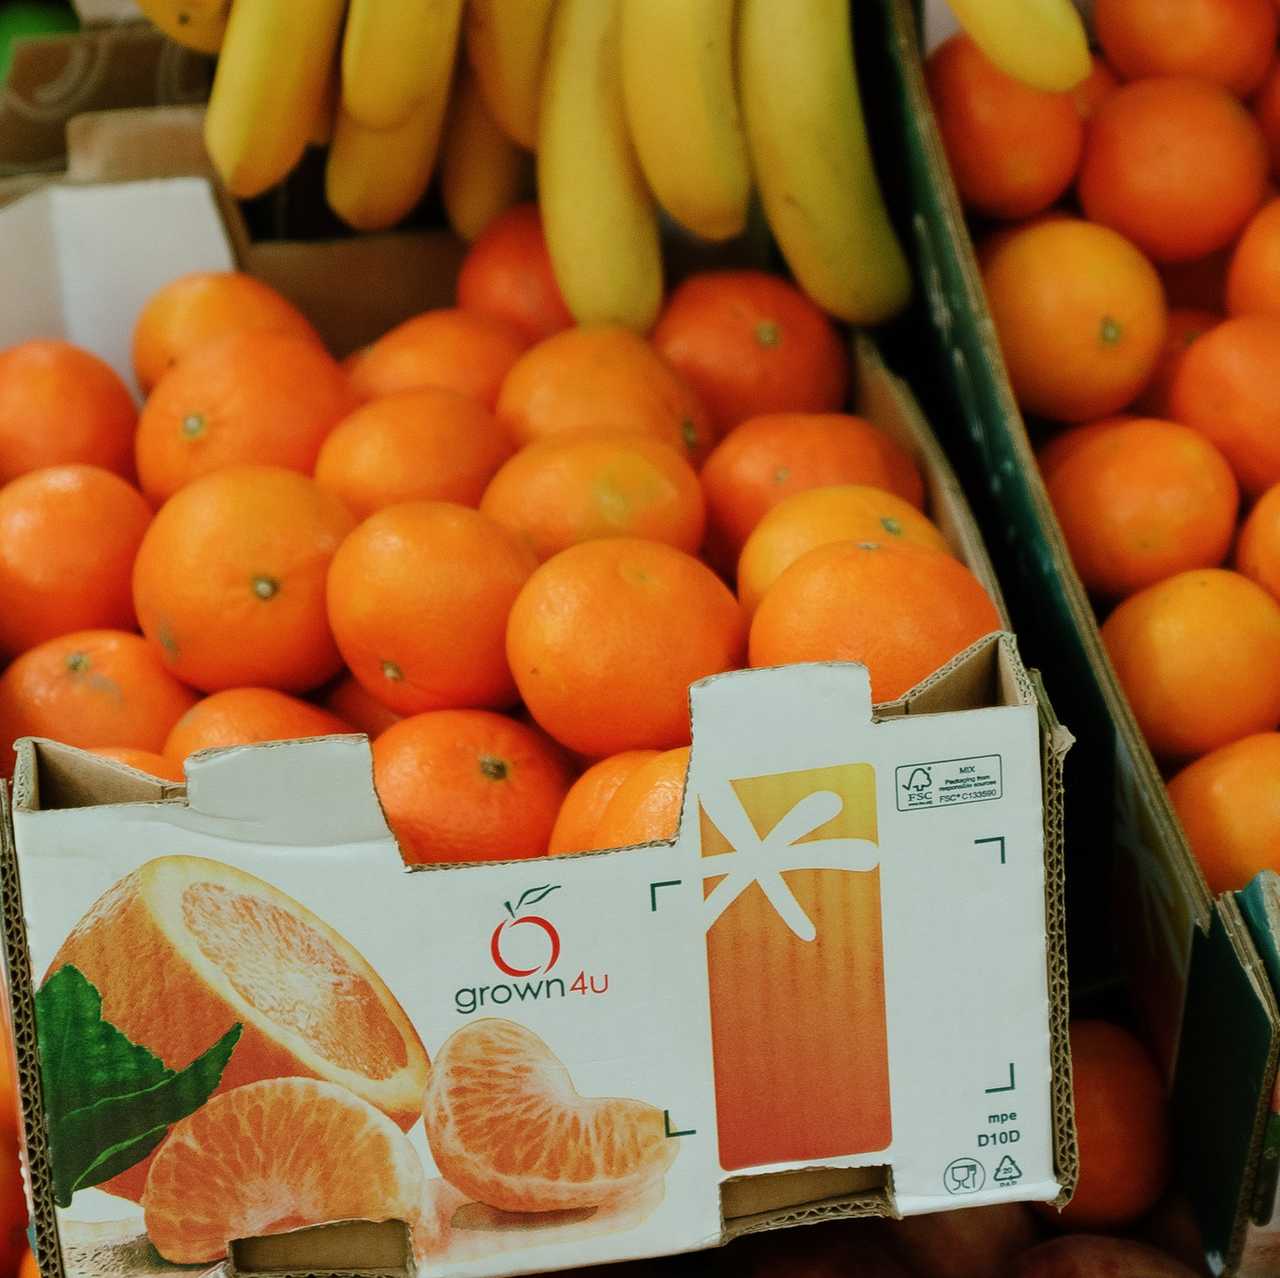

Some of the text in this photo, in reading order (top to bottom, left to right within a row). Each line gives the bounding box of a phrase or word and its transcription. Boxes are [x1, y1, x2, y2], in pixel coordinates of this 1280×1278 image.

[959, 766, 975, 774] MIX
[945, 776, 975, 785] Packaging
[939, 783, 972, 791] responsible
[908, 792, 932, 801] FSC
[962, 789, 997, 800] C133590
[455, 971, 608, 1014] grown4u
[988, 1112, 1017, 1124] mpe
[977, 1130, 1020, 1147] D10D
[1002, 1167, 1012, 1175] 20
